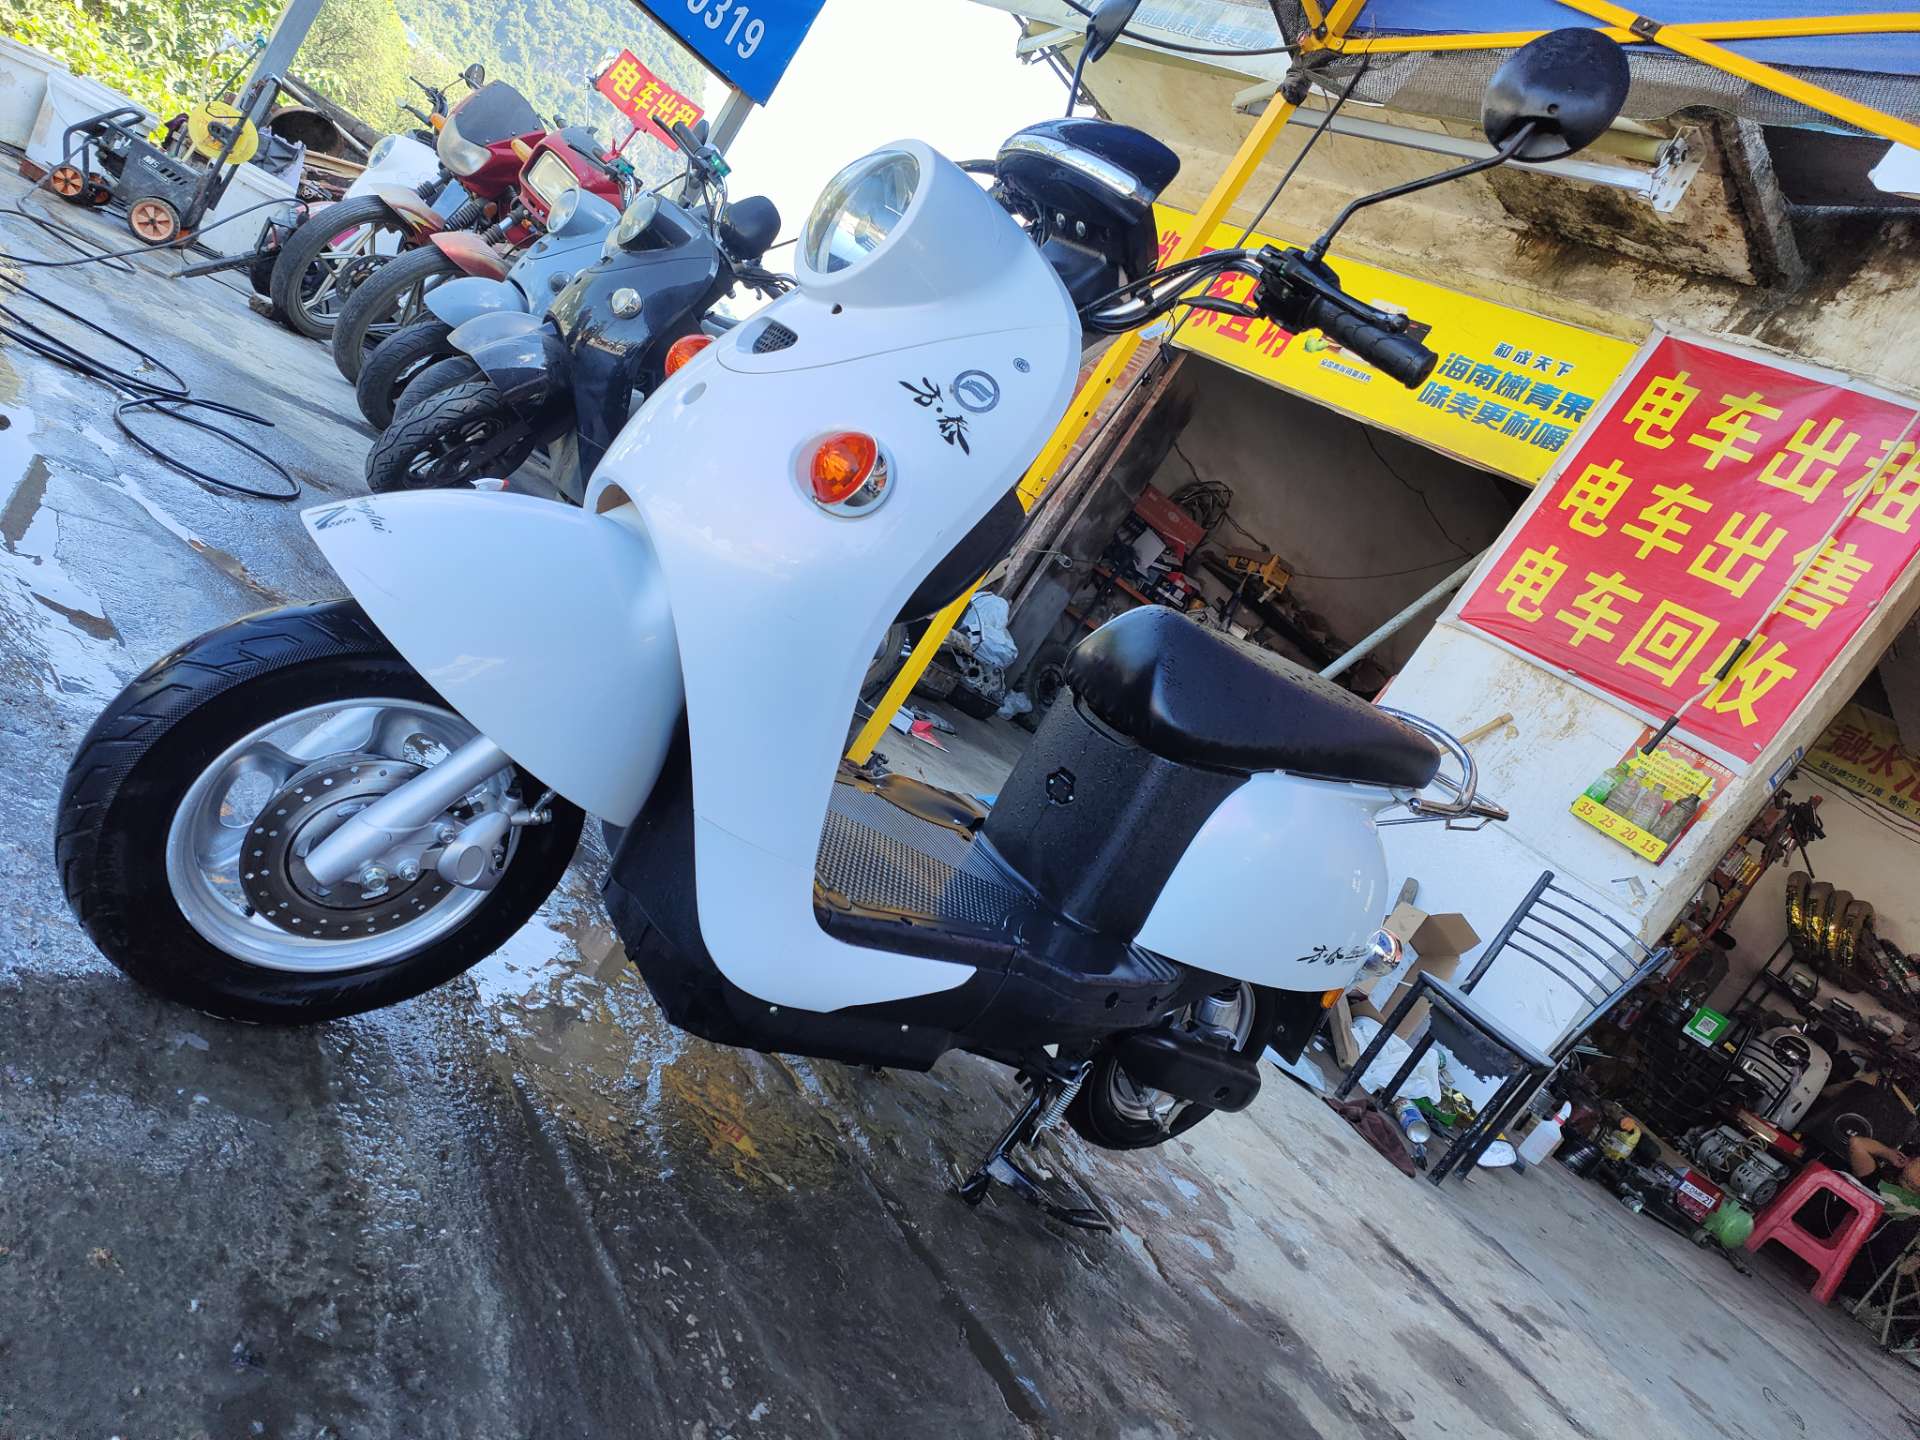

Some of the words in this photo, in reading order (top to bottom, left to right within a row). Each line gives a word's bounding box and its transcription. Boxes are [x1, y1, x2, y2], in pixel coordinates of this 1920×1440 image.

[609, 59, 698, 129] 电车出租
[1437, 352, 1596, 423] 海南嫩青果
[1494, 342, 1575, 378] 和成天下
[1417, 381, 1574, 453] 味美更耐嚼
[1623, 371, 1920, 534] 电车出租
[1558, 458, 1874, 631] 电车出售
[1496, 544, 1798, 728] 电车回收
